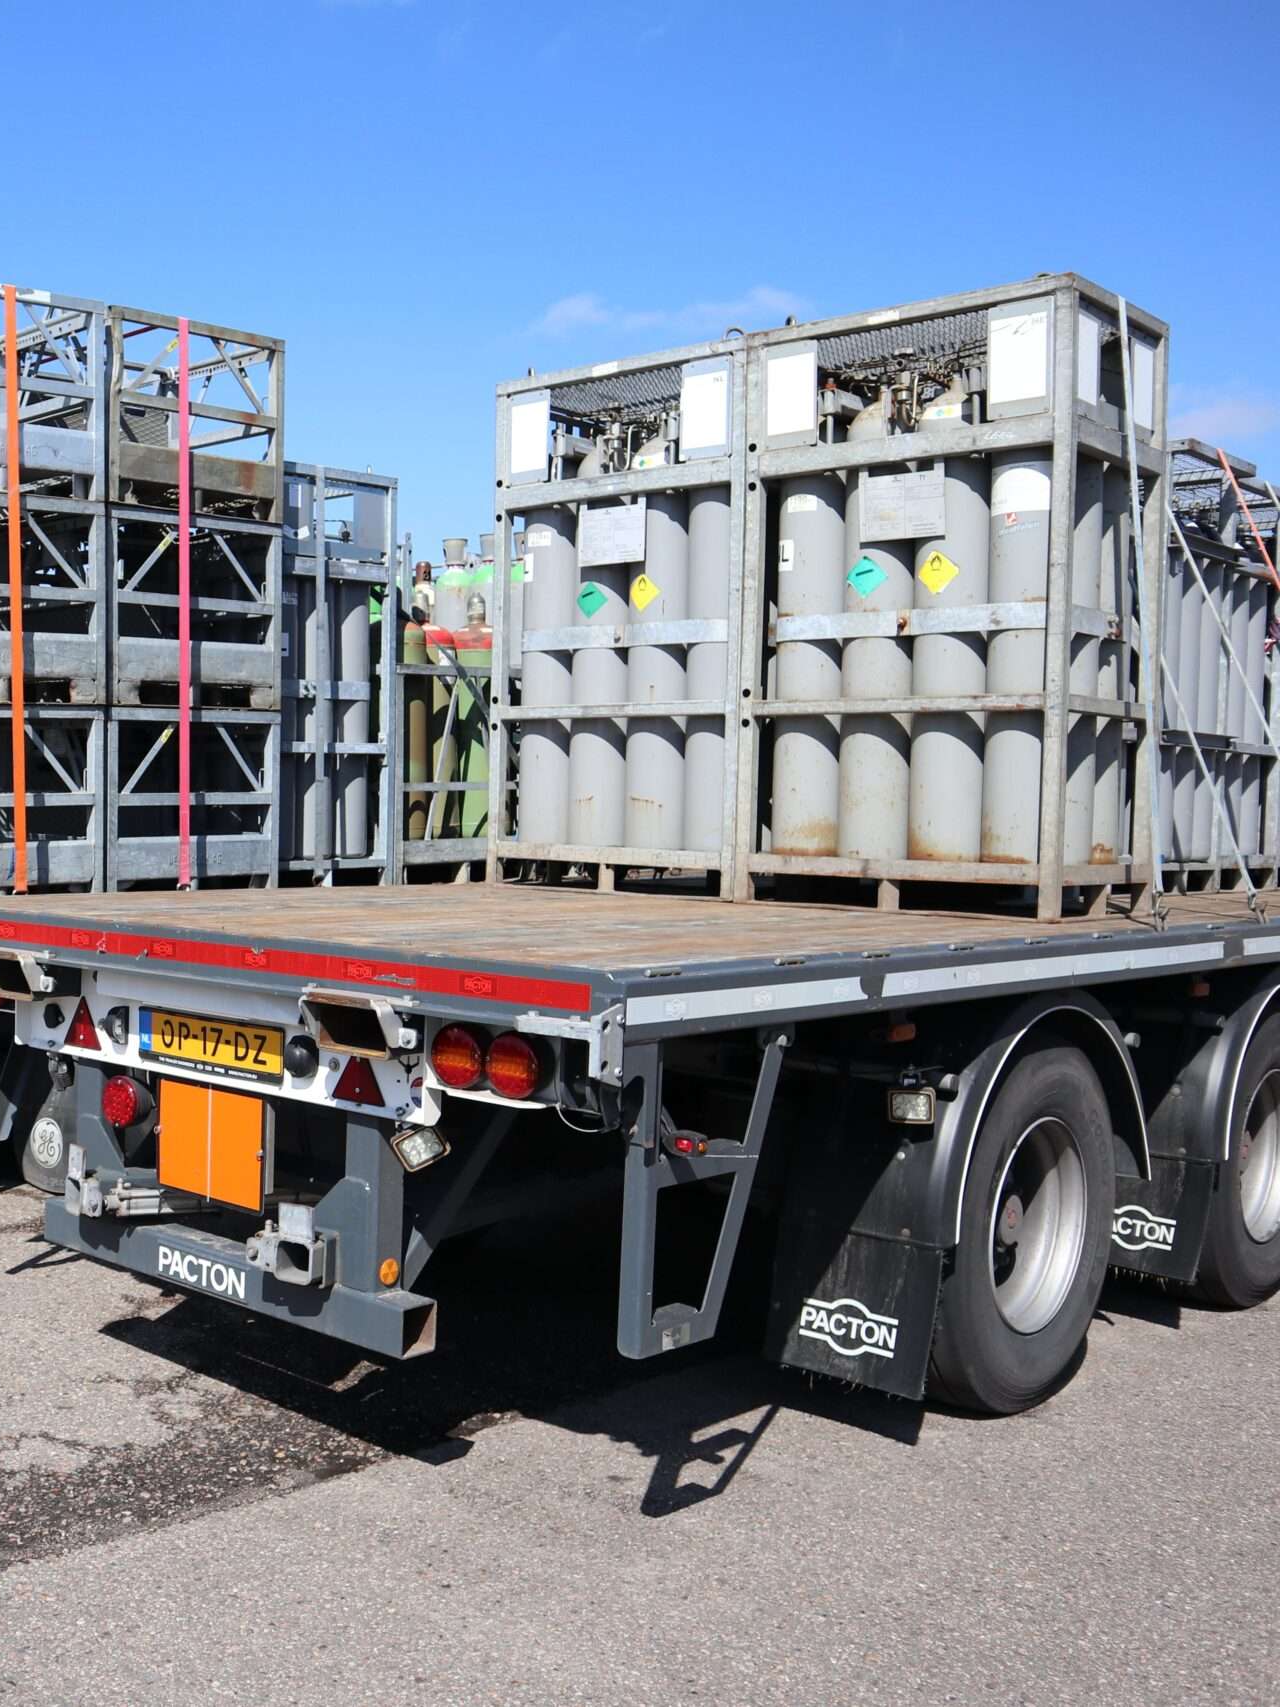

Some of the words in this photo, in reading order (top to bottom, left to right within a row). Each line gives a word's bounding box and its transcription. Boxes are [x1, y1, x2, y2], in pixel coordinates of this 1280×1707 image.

[161, 1019, 267, 1065] OP-17-DZ
[1113, 1217, 1175, 1244] CTON
[158, 1245, 245, 1299] PACTON
[800, 1305, 897, 1350] PACTON
